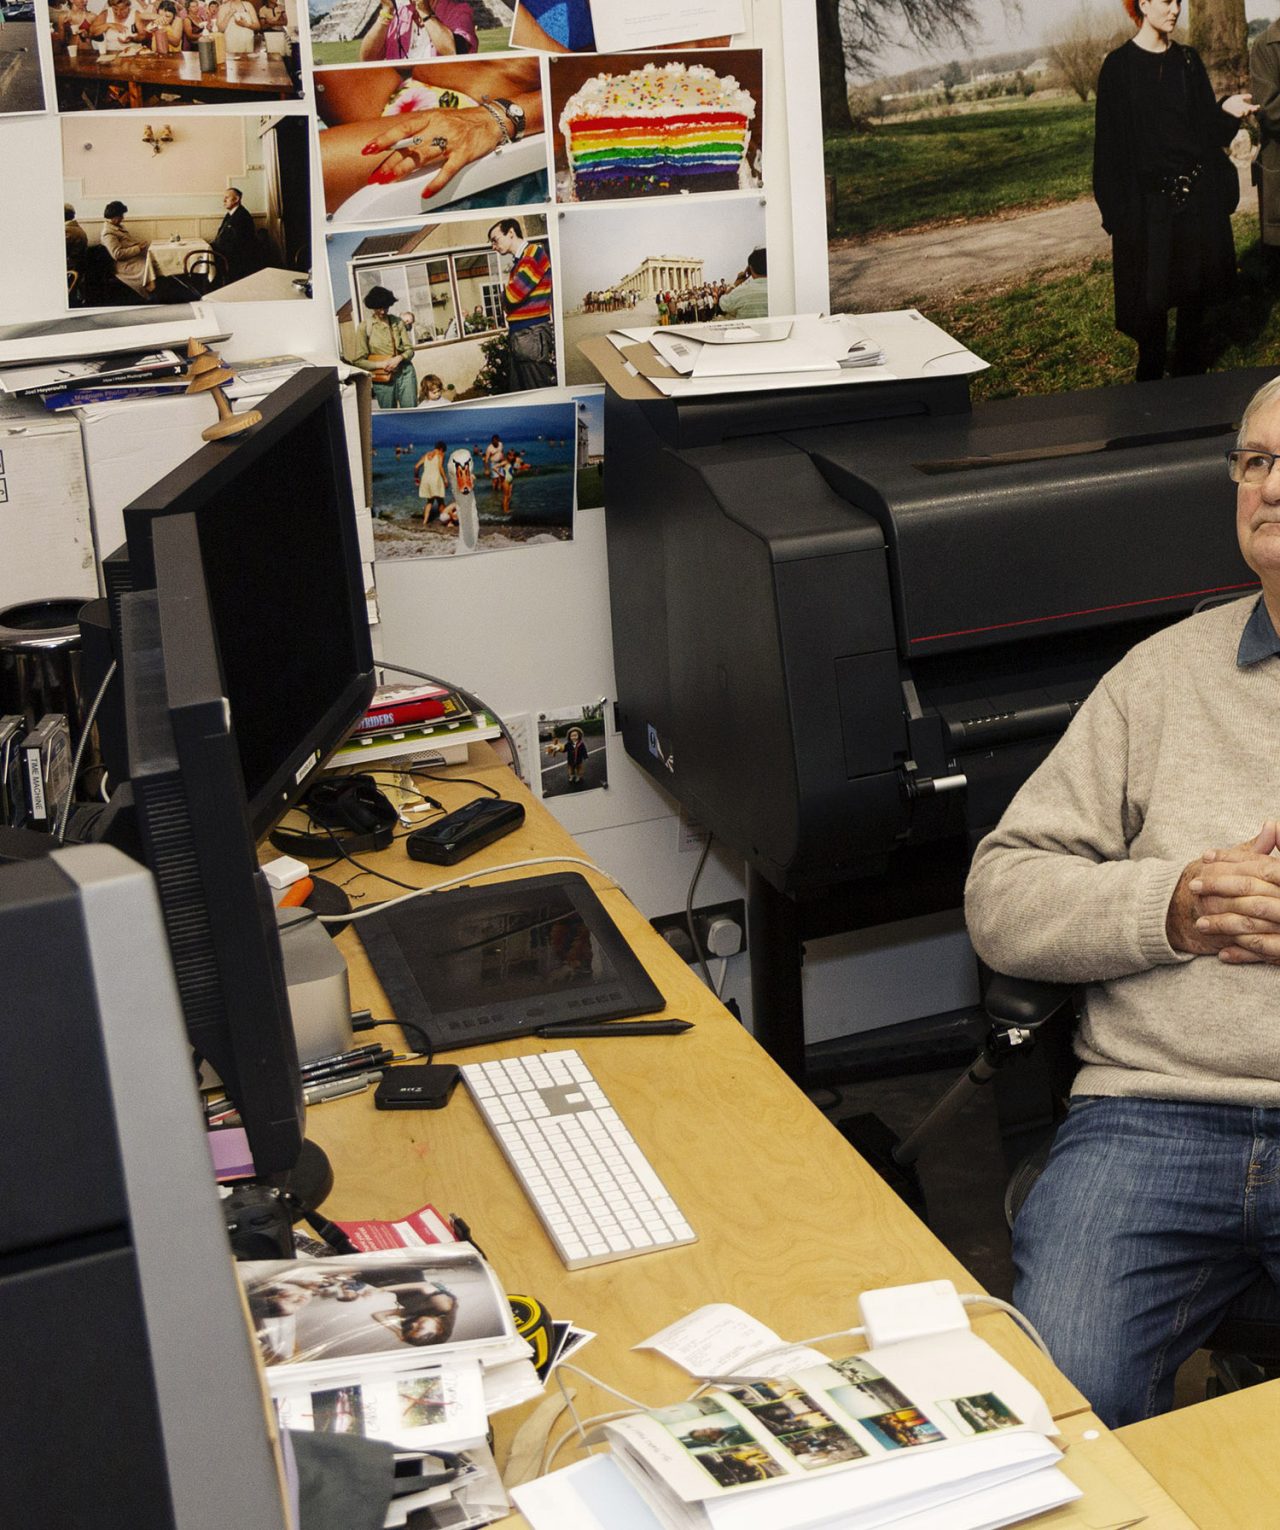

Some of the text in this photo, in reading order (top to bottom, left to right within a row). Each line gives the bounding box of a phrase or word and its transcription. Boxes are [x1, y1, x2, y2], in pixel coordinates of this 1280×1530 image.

[24, 388, 36, 396] Joel
[31, 759, 43, 810] TIME MACHINE
